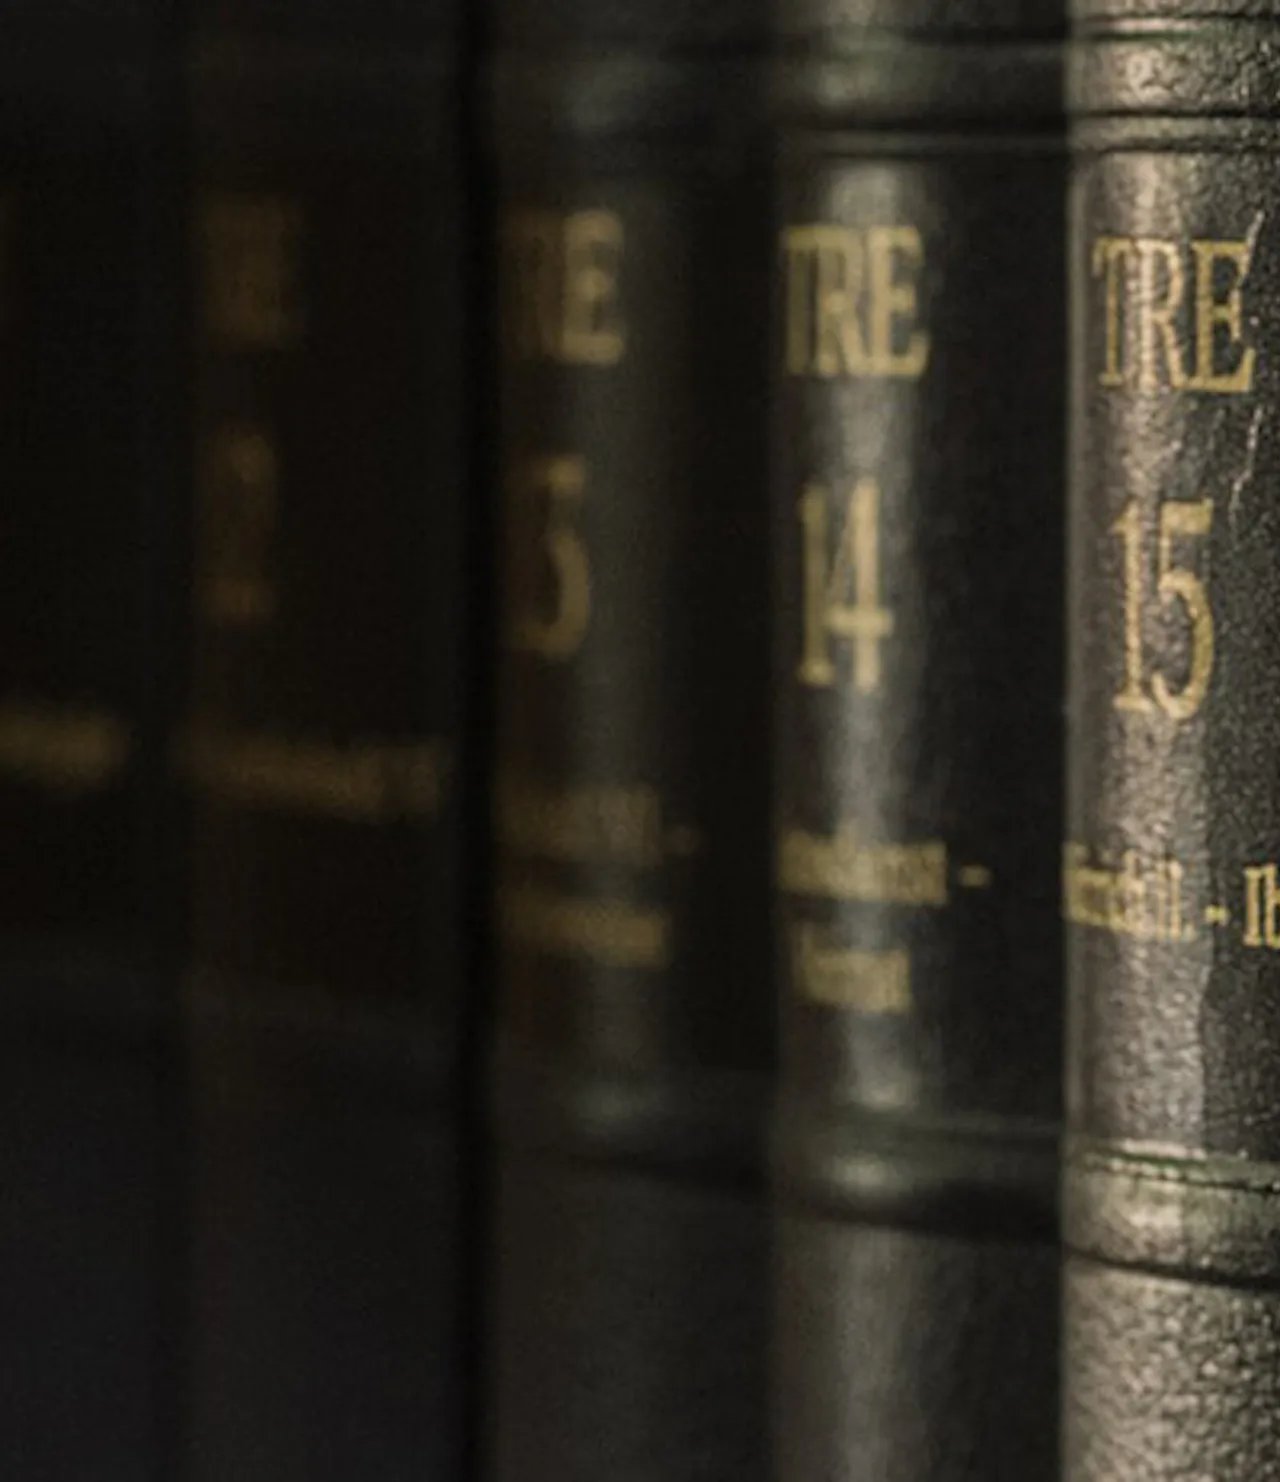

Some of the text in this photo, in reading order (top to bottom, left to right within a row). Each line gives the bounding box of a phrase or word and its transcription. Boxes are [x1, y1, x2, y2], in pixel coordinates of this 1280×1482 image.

[780, 223, 931, 379] TRE
[1092, 238, 1257, 393] TRE
[797, 477, 894, 695] 14
[1109, 498, 1216, 722] 15
